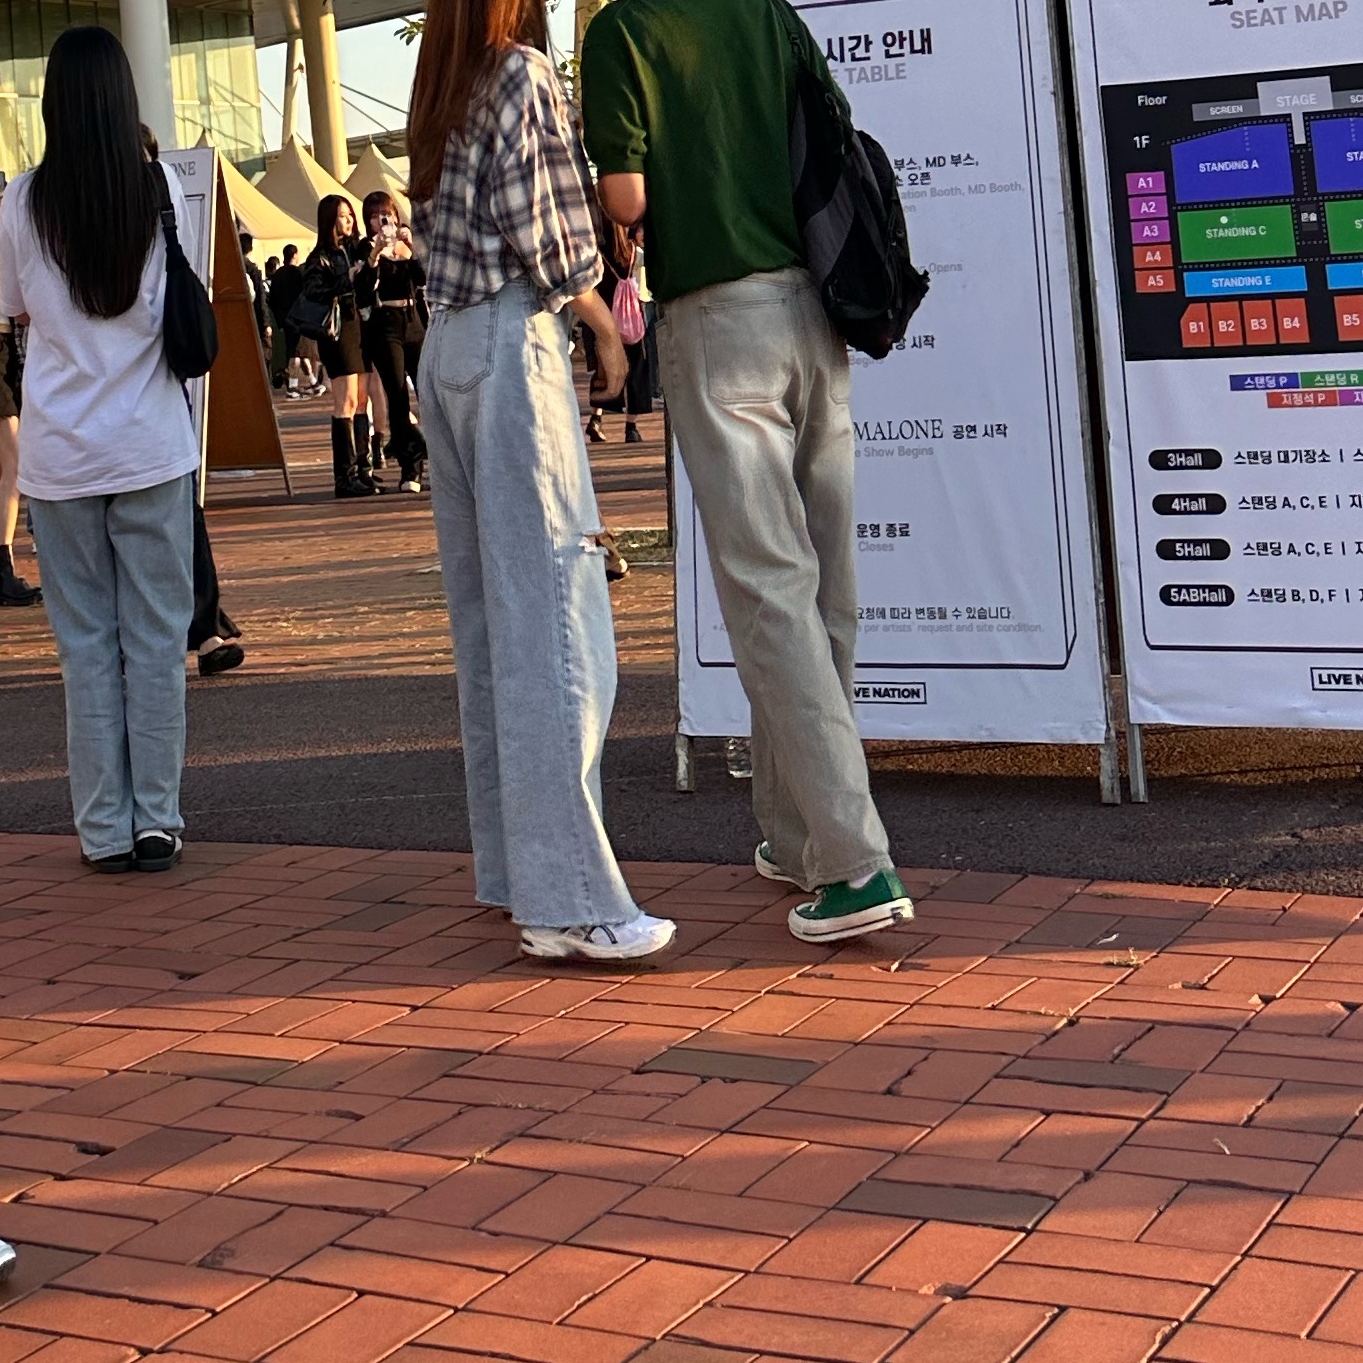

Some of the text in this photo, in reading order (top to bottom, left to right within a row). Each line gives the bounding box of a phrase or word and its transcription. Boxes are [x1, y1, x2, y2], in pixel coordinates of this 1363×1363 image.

[1230, 0, 1349, 29] SEAT MAP
[882, 27, 933, 59] 안내
[844, 62, 907, 84] TABLE
[1137, 95, 1168, 106] Floor
[1276, 94, 1318, 107] STAGE
[1209, 105, 1244, 116] SCREEN
[1133, 135, 1150, 149] 1F
[925, 156, 946, 168] MD
[950, 153, 979, 167] 부스,
[1199, 159, 1259, 173] STANDING A
[907, 171, 932, 187] 오픈
[1137, 177, 1153, 189] A1
[930, 186, 965, 198] Booth,
[968, 184, 986, 195] MD
[989, 180, 1025, 194] Booth,
[1140, 201, 1156, 213] A2
[1142, 225, 1159, 237] A3
[1206, 225, 1267, 239] STANDING C
[1145, 251, 1161, 262] A4
[929, 262, 963, 275] Opens
[1147, 275, 1164, 287] A5
[1211, 275, 1272, 288] STANDING E
[1189, 313, 1361, 333] B1 B2 B3 B4 B5
[911, 334, 935, 349] 시작
[1279, 376, 1288, 386] P
[1350, 373, 1359, 384] R
[1281, 392, 1326, 405] 지정석 P
[853, 419, 1008, 441] MALONE 공연 시작
[864, 445, 894, 457] Show
[898, 445, 934, 458] Begins
[1277, 448, 1331, 465] 대기장소
[1167, 453, 1203, 467] 3Hall
[1171, 497, 1207, 511] 4Hall
[1281, 496, 1296, 511] A,
[1299, 496, 1315, 510] C,
[1318, 496, 1328, 508] E
[856, 523, 911, 538] 운영 종료
[858, 541, 895, 552] Closes
[1175, 542, 1211, 557] 5Hall
[1287, 542, 1302, 557] A,
[1305, 542, 1320, 557] C,
[1324, 542, 1333, 555] E
[1170, 588, 1227, 603] 5ABHall
[1291, 589, 1306, 604] B,
[1309, 589, 1324, 604] D,
[1328, 589, 1337, 602] F
[889, 607, 911, 620] 따라
[951, 607, 963, 620] 수
[864, 623, 880, 634] per
[917, 623, 953, 634] request
[955, 622, 973, 633] and
[976, 622, 994, 633] site
[1318, 673, 1353, 685] LIVE
[873, 688, 921, 699] NATION
